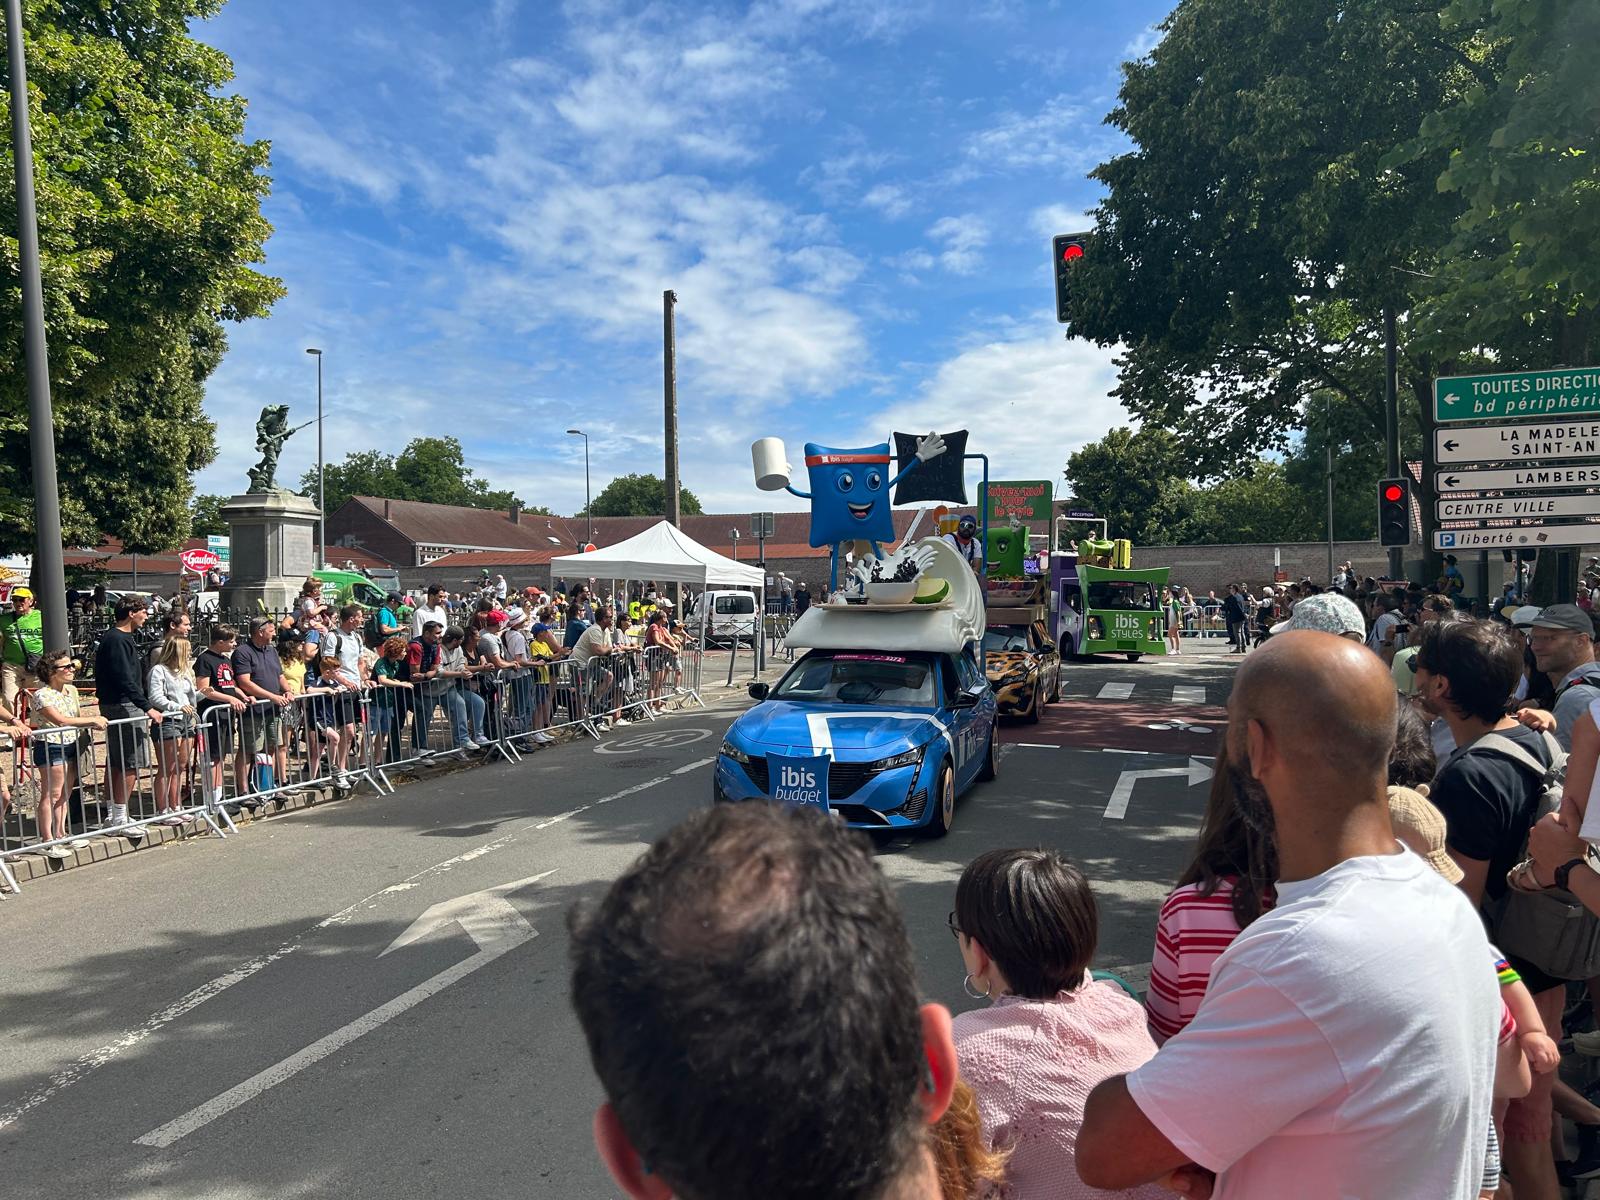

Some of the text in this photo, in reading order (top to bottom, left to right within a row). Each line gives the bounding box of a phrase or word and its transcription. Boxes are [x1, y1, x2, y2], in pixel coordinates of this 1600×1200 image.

[1472, 374, 1600, 396] TOUTES DIRECTI
[1474, 392, 1600, 415] bd périphéri
[1501, 425, 1600, 441] LA MADELE
[1511, 440, 1595, 455] SAINT-AN
[1516, 470, 1599, 484] LAMBERS
[1444, 500, 1555, 515] CENTRE VILLE
[1442, 532, 1513, 546] P liberté
[187, 551, 218, 567] Gaulois
[1115, 613, 1139, 629] ibis
[781, 766, 816, 788] ibis
[775, 785, 822, 805] budget
